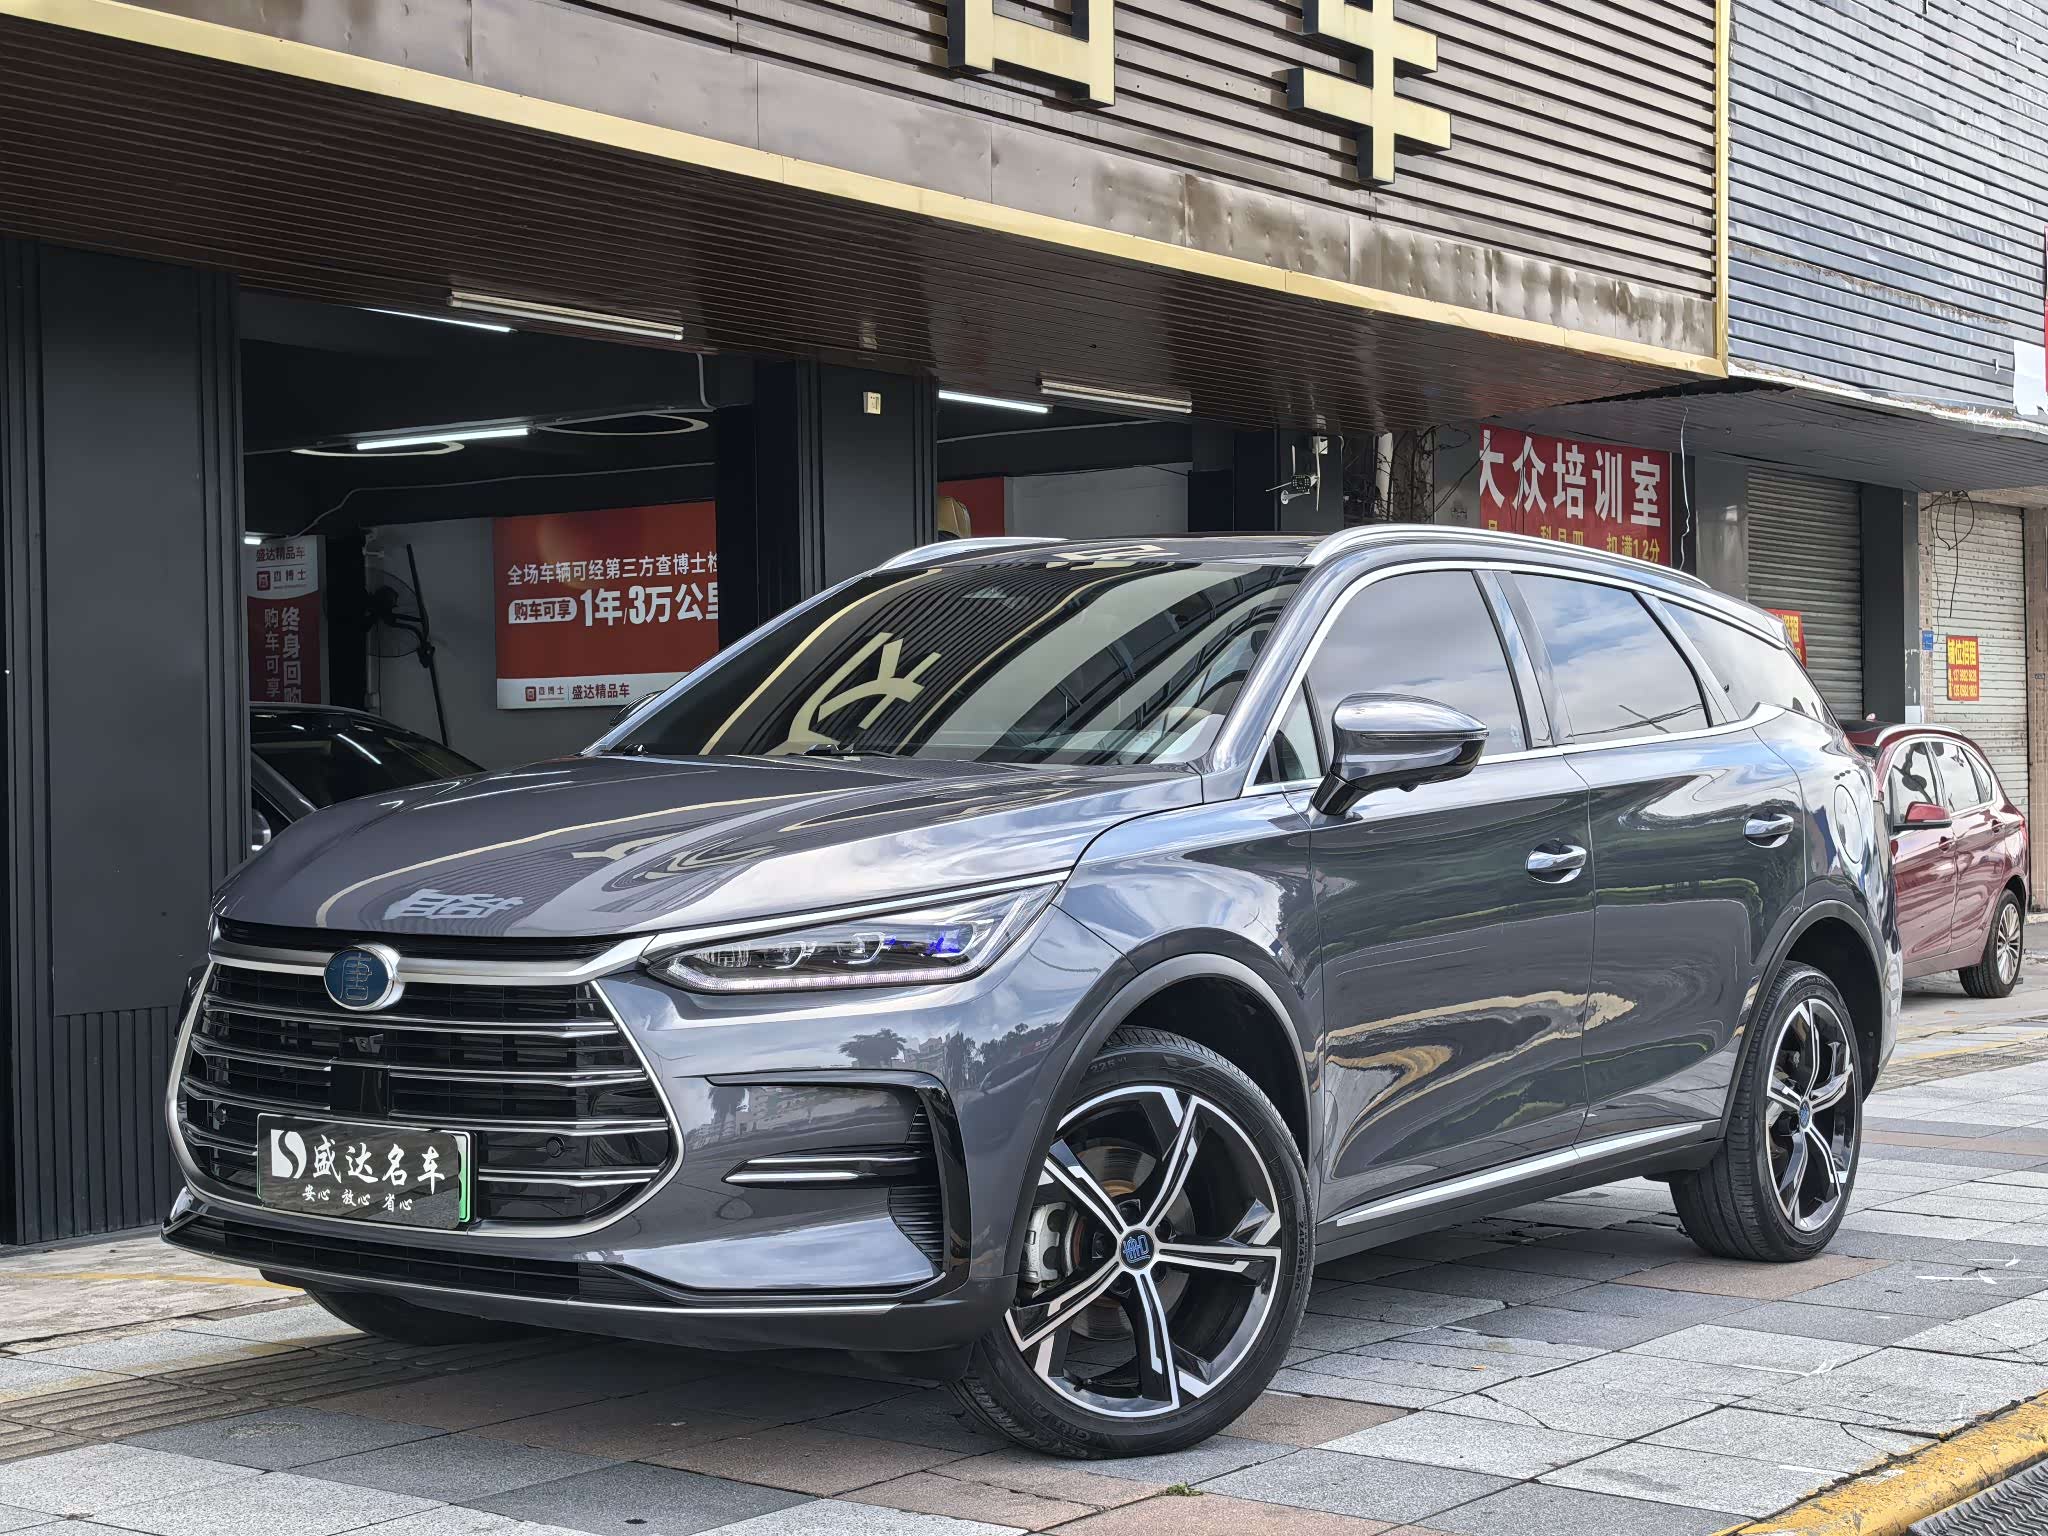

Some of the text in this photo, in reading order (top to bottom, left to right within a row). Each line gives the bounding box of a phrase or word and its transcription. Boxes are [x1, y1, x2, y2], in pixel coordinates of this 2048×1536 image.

[1480, 429, 1661, 527] 大众培训室
[514, 599, 572, 621] 购车可享
[264, 608, 280, 698] 购车可享
[572, 683, 630, 700] 盛达精品车
[312, 1134, 445, 1195] 盛达名车
[302, 1184, 413, 1212] 安心 放心 省心
